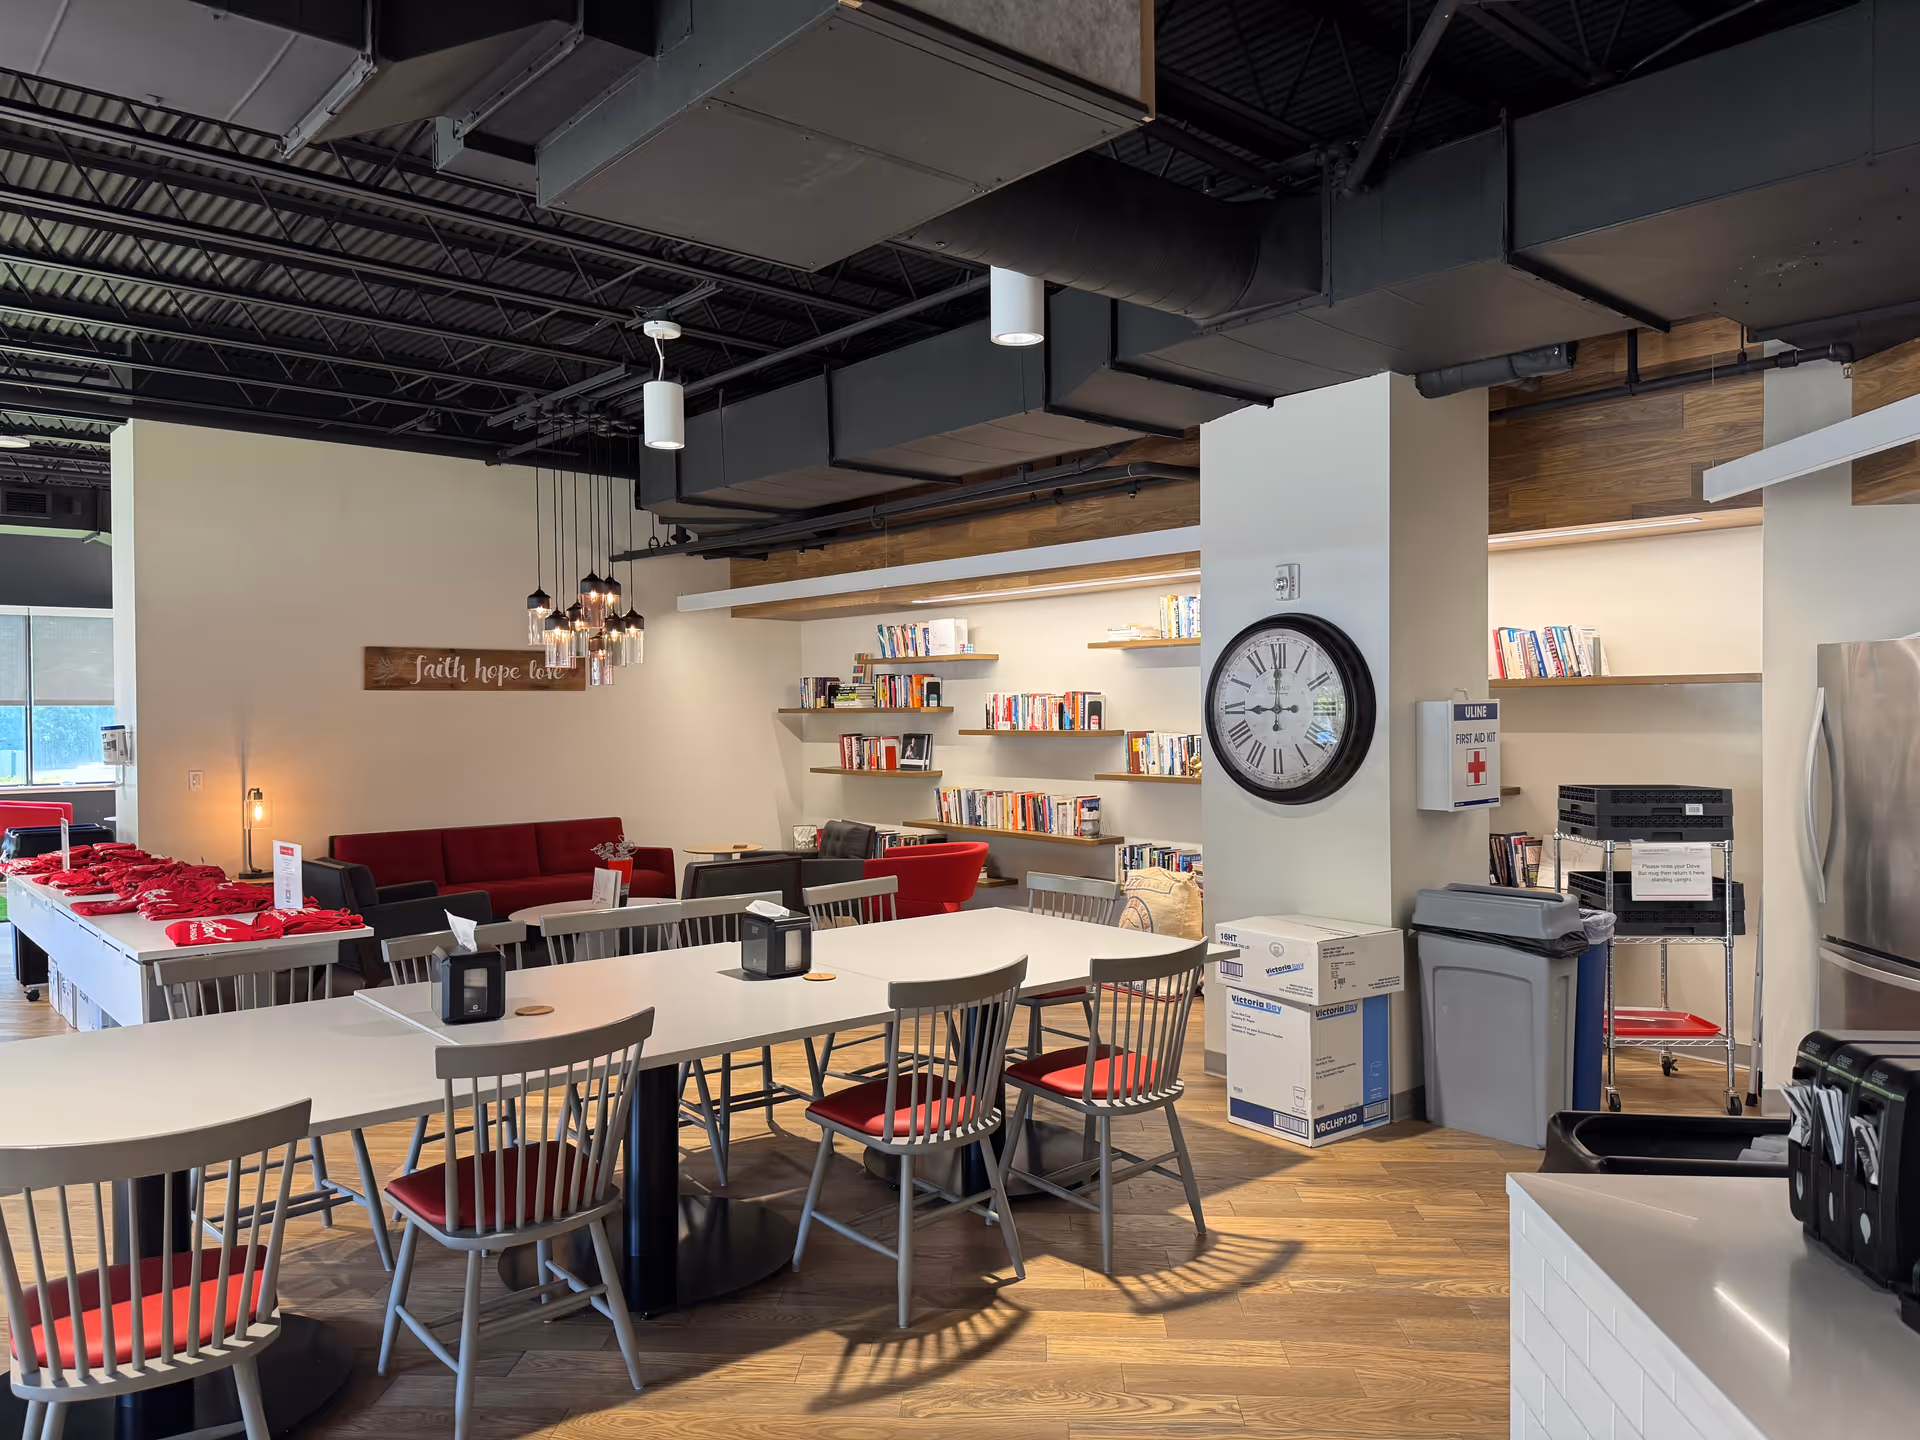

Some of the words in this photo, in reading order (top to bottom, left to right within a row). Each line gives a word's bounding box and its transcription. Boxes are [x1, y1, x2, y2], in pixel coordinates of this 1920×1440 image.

[410, 655, 468, 684] faith
[475, 658, 521, 686] hope
[529, 660, 565, 680] love
[1465, 706, 1486, 718] ULINE
[1456, 734, 1472, 744] FIRST
[1474, 733, 1485, 743] AID
[1487, 732, 1496, 742] KIT
[1220, 933, 1237, 941] 16HT
[1265, 964, 1291, 974] Victoria
[1232, 995, 1264, 1008] Victoria
[1266, 1003, 1282, 1012] Bay
[1316, 1005, 1344, 1017] Victoria
[1316, 1114, 1357, 1132] VBCLHP12D
